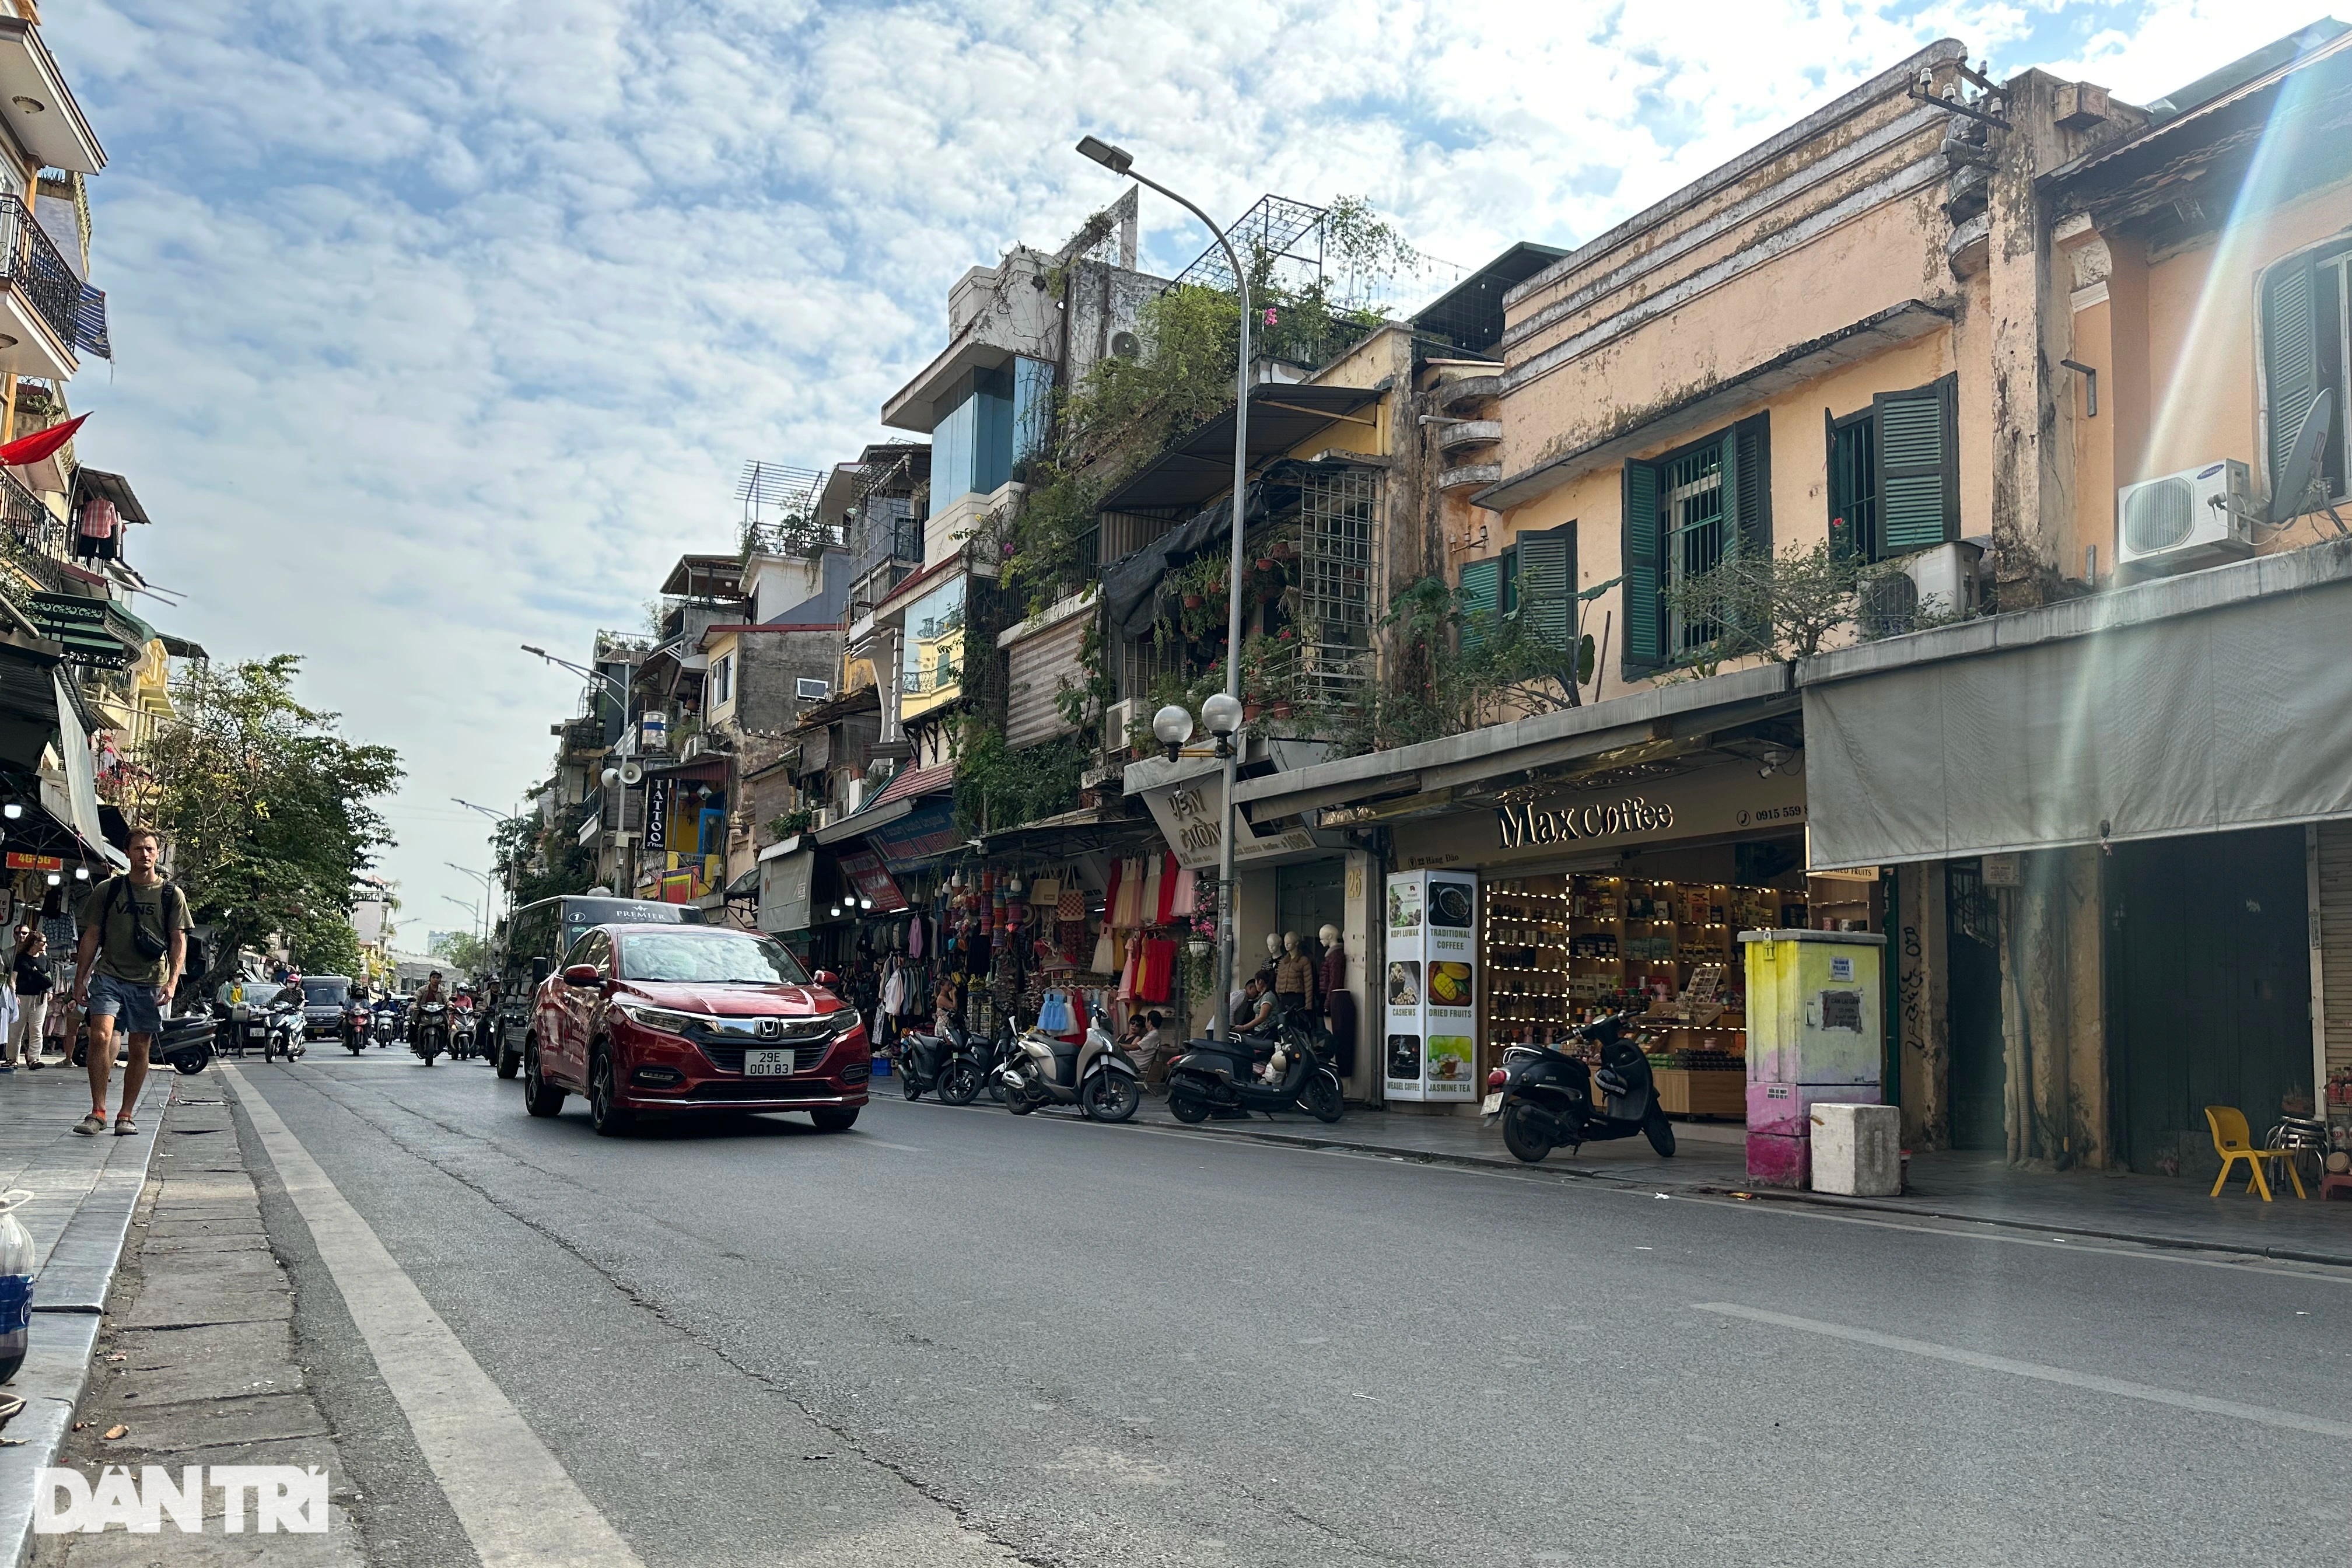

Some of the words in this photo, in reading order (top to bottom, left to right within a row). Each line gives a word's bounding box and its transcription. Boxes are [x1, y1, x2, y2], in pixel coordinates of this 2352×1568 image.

[2199, 465, 2223, 478] SAMSUNG
[650, 779, 664, 842] TATTOO
[1756, 808, 1779, 821] 0915
[1783, 806, 1801, 817] 559
[1493, 801, 1581, 849] Max
[18, 853, 51, 864] 4G-5G
[1426, 855, 1443, 864] Hàng
[1446, 853, 1459, 862] Đào
[1852, 868, 1872, 876] FRUITS
[1348, 867, 1362, 898] 26
[1233, 886, 1238, 913] 6
[617, 911, 666, 921] PREMIER
[1391, 929, 1401, 938] KOPI
[1402, 929, 1419, 937] LUWAK
[1430, 928, 1471, 939] TRADITIONAL
[1392, 1008, 1416, 1017] CASHEWS
[1429, 1009, 1448, 1017] DRIED
[1450, 1009, 1472, 1018] FRUITS
[760, 1052, 780, 1062] 29E
[750, 1063, 789, 1074] 001.83
[1387, 1082, 1404, 1090] WEASEL
[1405, 1083, 1420, 1091] COFFEE
[1428, 1084, 1457, 1093] JASMINE
[1459, 1084, 1471, 1093] TEA
